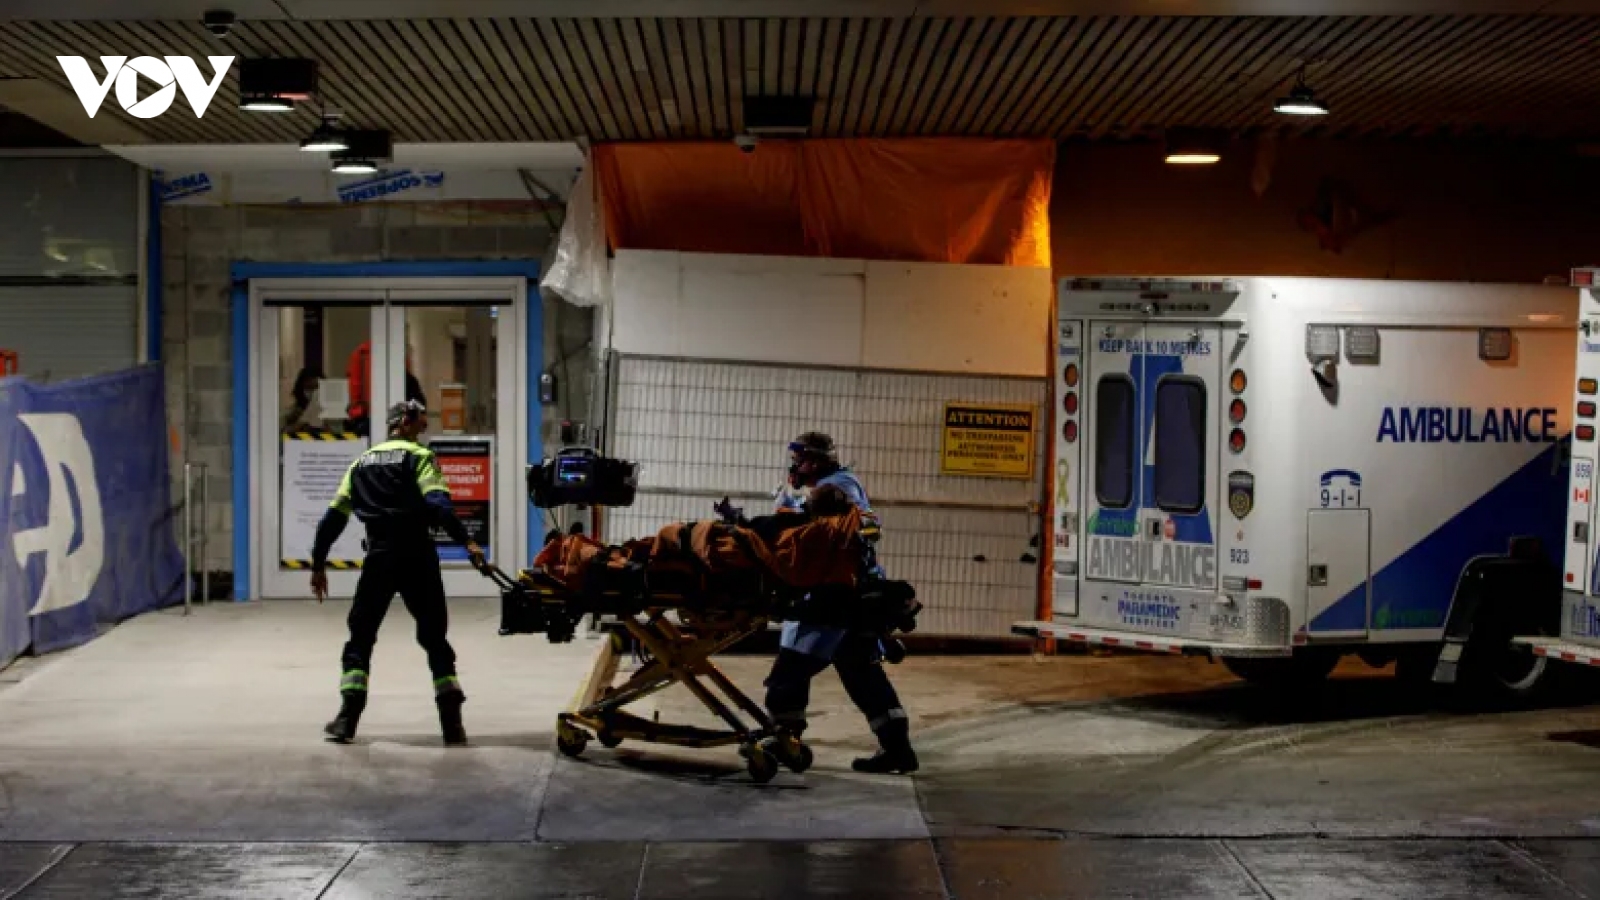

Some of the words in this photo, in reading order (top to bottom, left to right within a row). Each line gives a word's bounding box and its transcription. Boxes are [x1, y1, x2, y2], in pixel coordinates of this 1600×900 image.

[1099, 339, 1123, 352] KEEP
[1126, 340, 1153, 353] BACK
[1156, 341, 1167, 354] 10
[1170, 341, 1211, 354] METRES
[949, 410, 1029, 427] ATTENTION
[1376, 406, 1557, 443] AMBULANCE
[441, 464, 482, 474] RGENCY
[1320, 489, 1360, 509] 9-1-1
[1089, 538, 1214, 586] AMBULANCE
[1230, 548, 1250, 564] 923
[1117, 599, 1180, 620] PARAMEDIC
